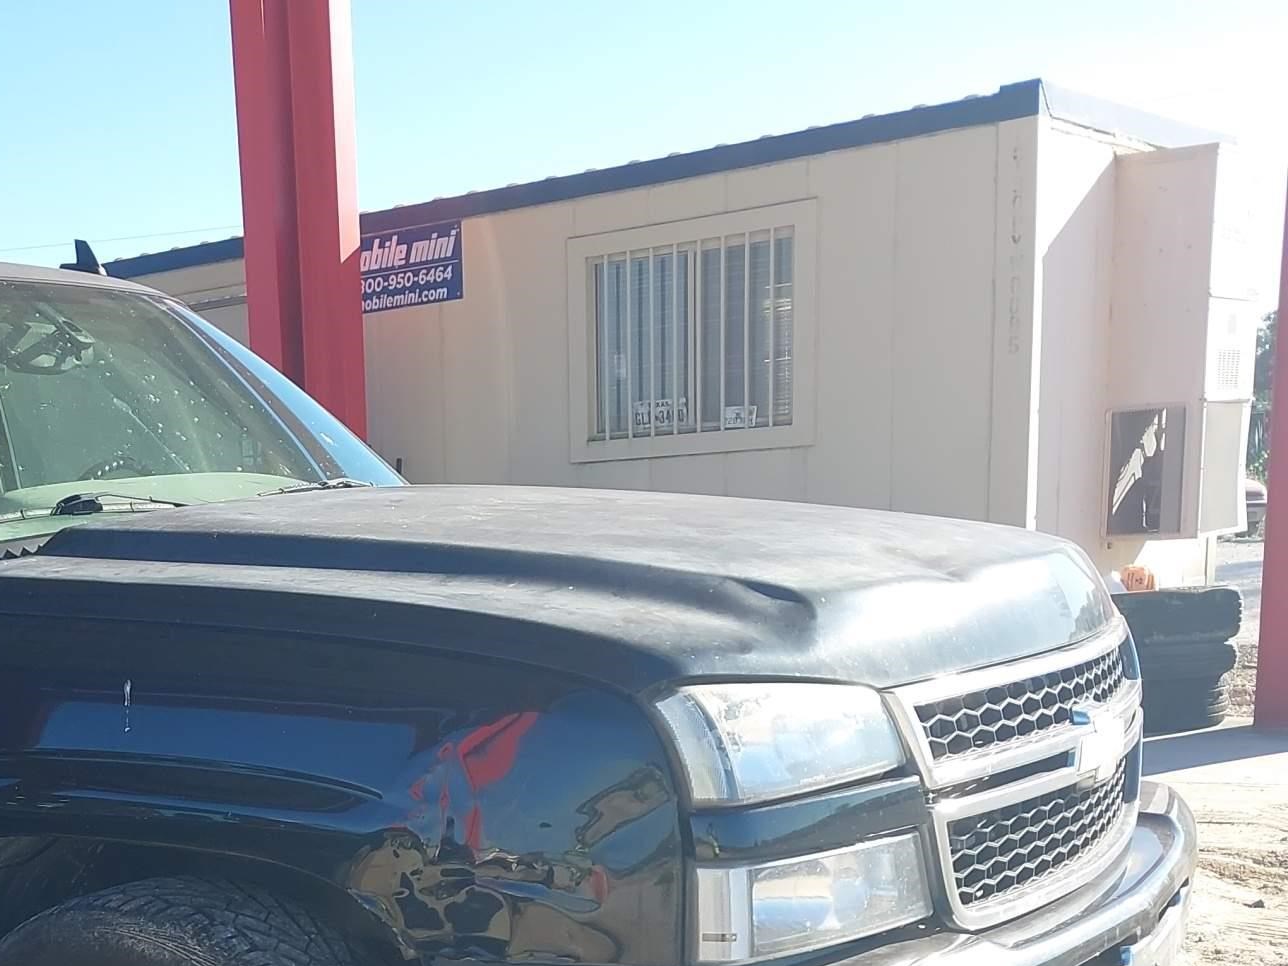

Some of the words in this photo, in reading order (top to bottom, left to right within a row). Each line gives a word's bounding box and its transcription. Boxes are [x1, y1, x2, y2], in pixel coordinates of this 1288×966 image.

[359, 235, 407, 271] obile
[409, 230, 456, 264] mini
[362, 287, 448, 312] obilemini.com
